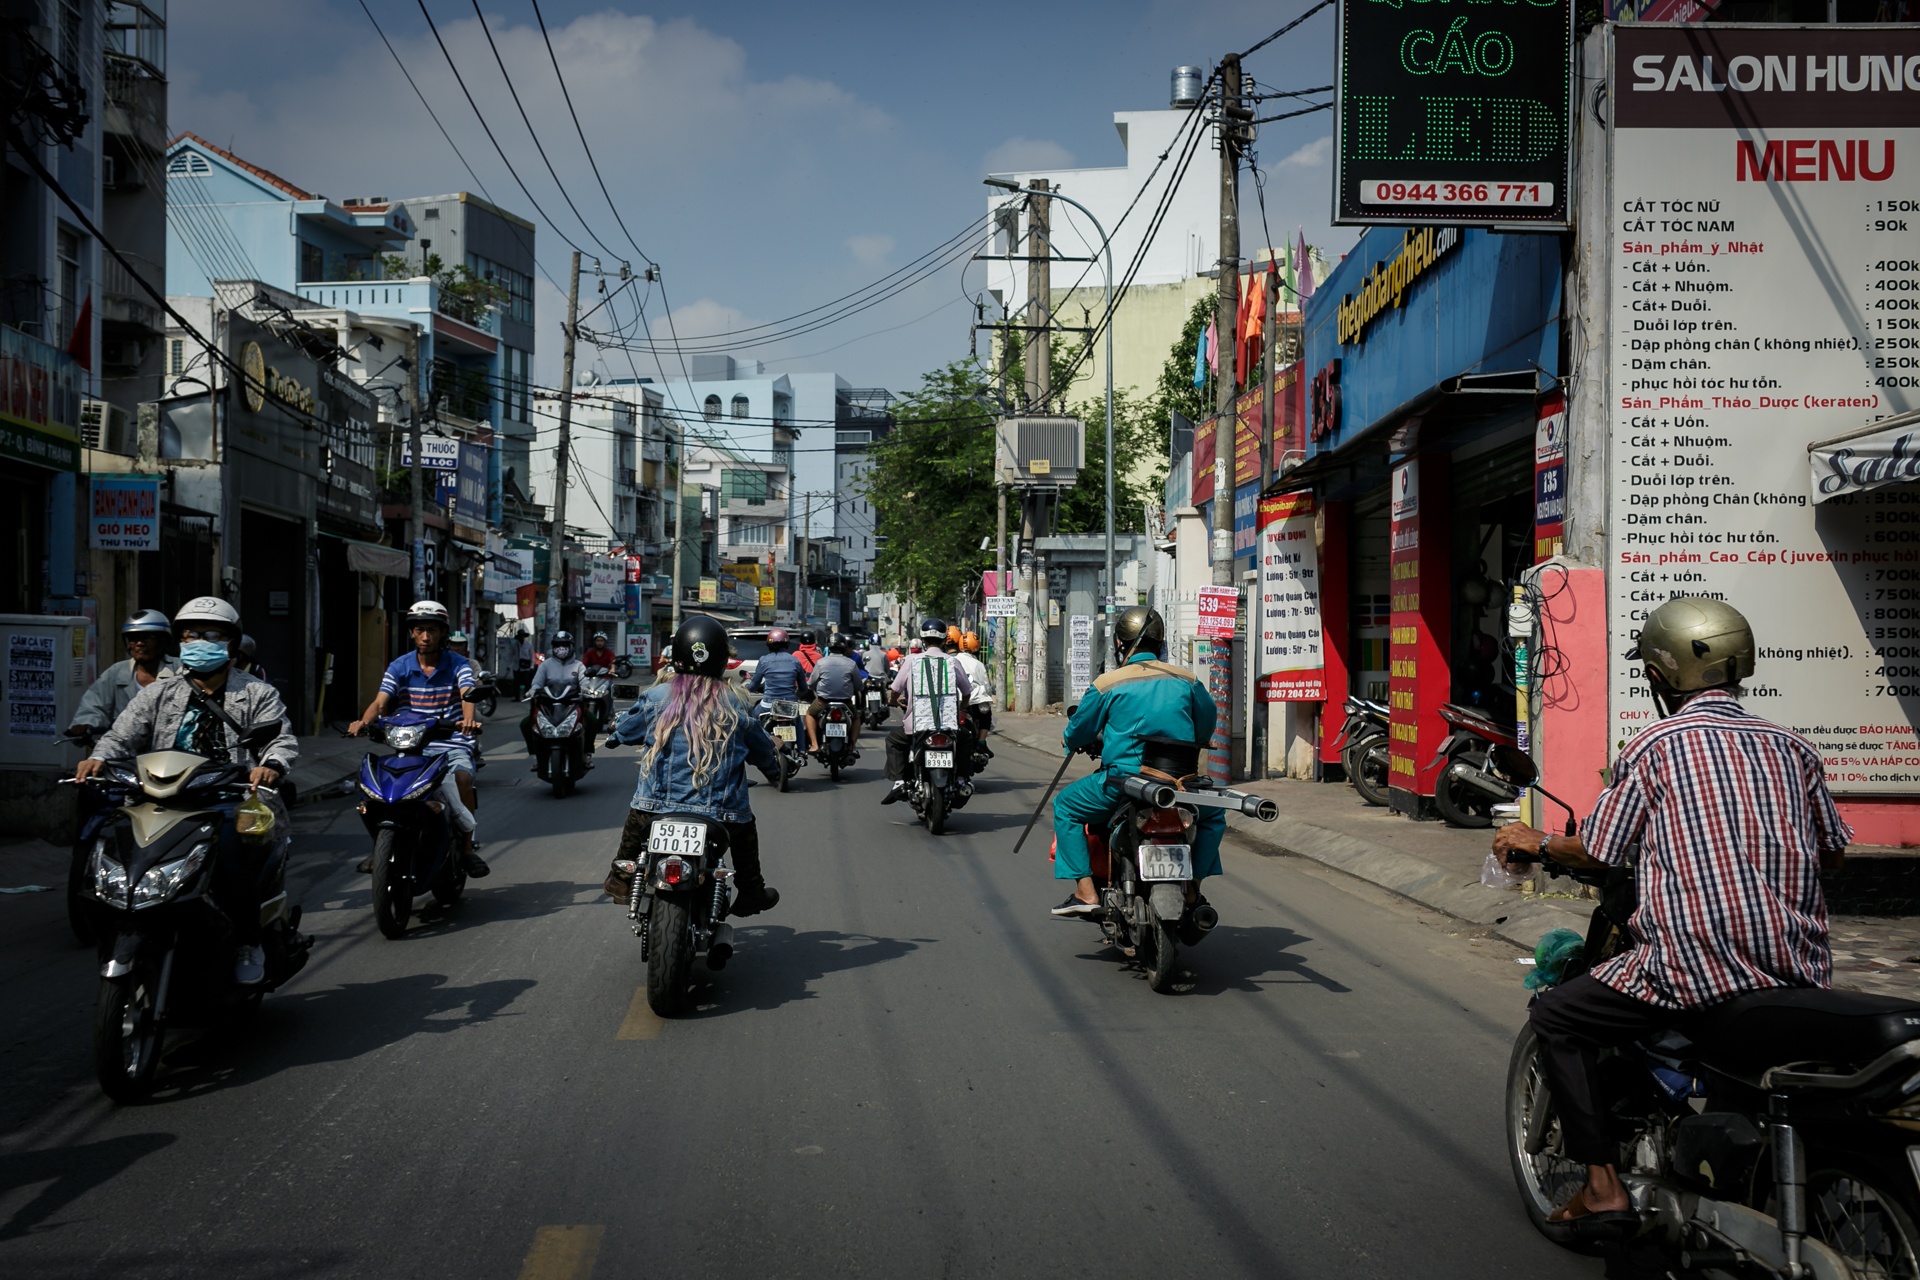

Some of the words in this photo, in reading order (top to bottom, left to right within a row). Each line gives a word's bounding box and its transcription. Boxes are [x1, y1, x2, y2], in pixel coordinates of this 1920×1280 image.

[1400, 16, 1514, 77] CÁO
[1633, 54, 1796, 92] SALON
[1352, 96, 1558, 161] LED
[1736, 139, 1895, 181] MENU
[1376, 183, 1437, 202] 0944
[1443, 184, 1488, 202] 366
[1497, 184, 1540, 202] 771
[1623, 197, 1656, 212] CẮT
[1660, 199, 1693, 212] TÓC
[1697, 199, 1720, 212] NỮ
[1876, 200, 1920, 212] 150k
[1623, 217, 1656, 232] CẮT
[1660, 218, 1693, 232] TÓC
[1697, 221, 1735, 232] NAM
[1874, 220, 1908, 231] 90k
[1632, 259, 1657, 273] Cắt
[1675, 259, 1710, 273] Uốn.
[1874, 260, 1920, 272] 400k
[1632, 279, 1657, 292] Cắt
[1675, 281, 1733, 294] Nhuộm.
[1874, 280, 1920, 291] 400k
[1874, 299, 1920, 310] 400k
[1673, 320, 1697, 333] lớp
[1701, 320, 1737, 331] trên.
[1876, 318, 1920, 330] 150k
[1631, 339, 1660, 353] Dập
[1664, 337, 1710, 353] phồng
[1714, 338, 1750, 350] chân
[1764, 338, 1810, 352] không
[1874, 338, 1920, 349] 250k
[1670, 358, 1711, 370] chân.
[1874, 357, 1920, 369] 250k
[1631, 378, 1669, 392] phục
[1673, 376, 1697, 389] hồi
[1701, 378, 1725, 389] tóc
[1729, 377, 1749, 389] hư
[1874, 376, 1920, 388] 400k
[1804, 394, 1879, 409] (keraten)
[1631, 415, 1656, 428] Cắt
[1674, 415, 1709, 428] Uốn.
[427, 441, 455, 454] THUỐC
[1631, 434, 1656, 447] Cắt
[1674, 436, 1732, 449] Nhuộm.
[432, 458, 453, 466] LỘC
[1631, 454, 1656, 467] Cắt
[1671, 475, 1694, 488] lớp
[1699, 475, 1735, 485] trên.
[1631, 494, 1659, 508] Dập
[1663, 492, 1709, 508] phồng
[1713, 493, 1749, 505] Chân
[1754, 492, 1806, 506] (không
[1665, 513, 1707, 524] chân.
[98, 520, 120, 535] GIÒ
[124, 524, 150, 535] HEO
[100, 539, 120, 547] THU
[124, 536, 151, 547] THỦY
[1670, 531, 1694, 543] hồi
[1698, 533, 1722, 543] tóc
[1727, 532, 1746, 543] hư
[1790, 551, 1848, 565] juvexin
[1853, 550, 1889, 565] phục
[1630, 569, 1655, 582] Cắt
[1673, 569, 1706, 582] uốn.
[1199, 596, 1219, 613] 539
[630, 636, 647, 645] RỬA
[1758, 647, 1802, 660] không
[1874, 647, 1920, 658] 400k
[1874, 666, 1920, 677] 400k
[1266, 689, 1286, 698] 0967
[1287, 689, 1303, 698] 204
[1305, 689, 1320, 698] 224
[1875, 686, 1920, 696] 700k
[1833, 726, 1857, 736] được
[1860, 724, 1883, 734] BẢO
[1886, 724, 1915, 734] HÀNH
[1819, 742, 1843, 752] hàng
[1860, 742, 1884, 752] được
[1841, 757, 1860, 766] 5%
[1863, 756, 1878, 766] VÀ
[1880, 756, 1903, 766] HẤP
[1842, 773, 1868, 782] 10%
[1870, 773, 1888, 782] cho
[1890, 773, 1911, 783] dịch
[652, 838, 701, 853] 010.12
[1150, 863, 1185, 878] 1022
